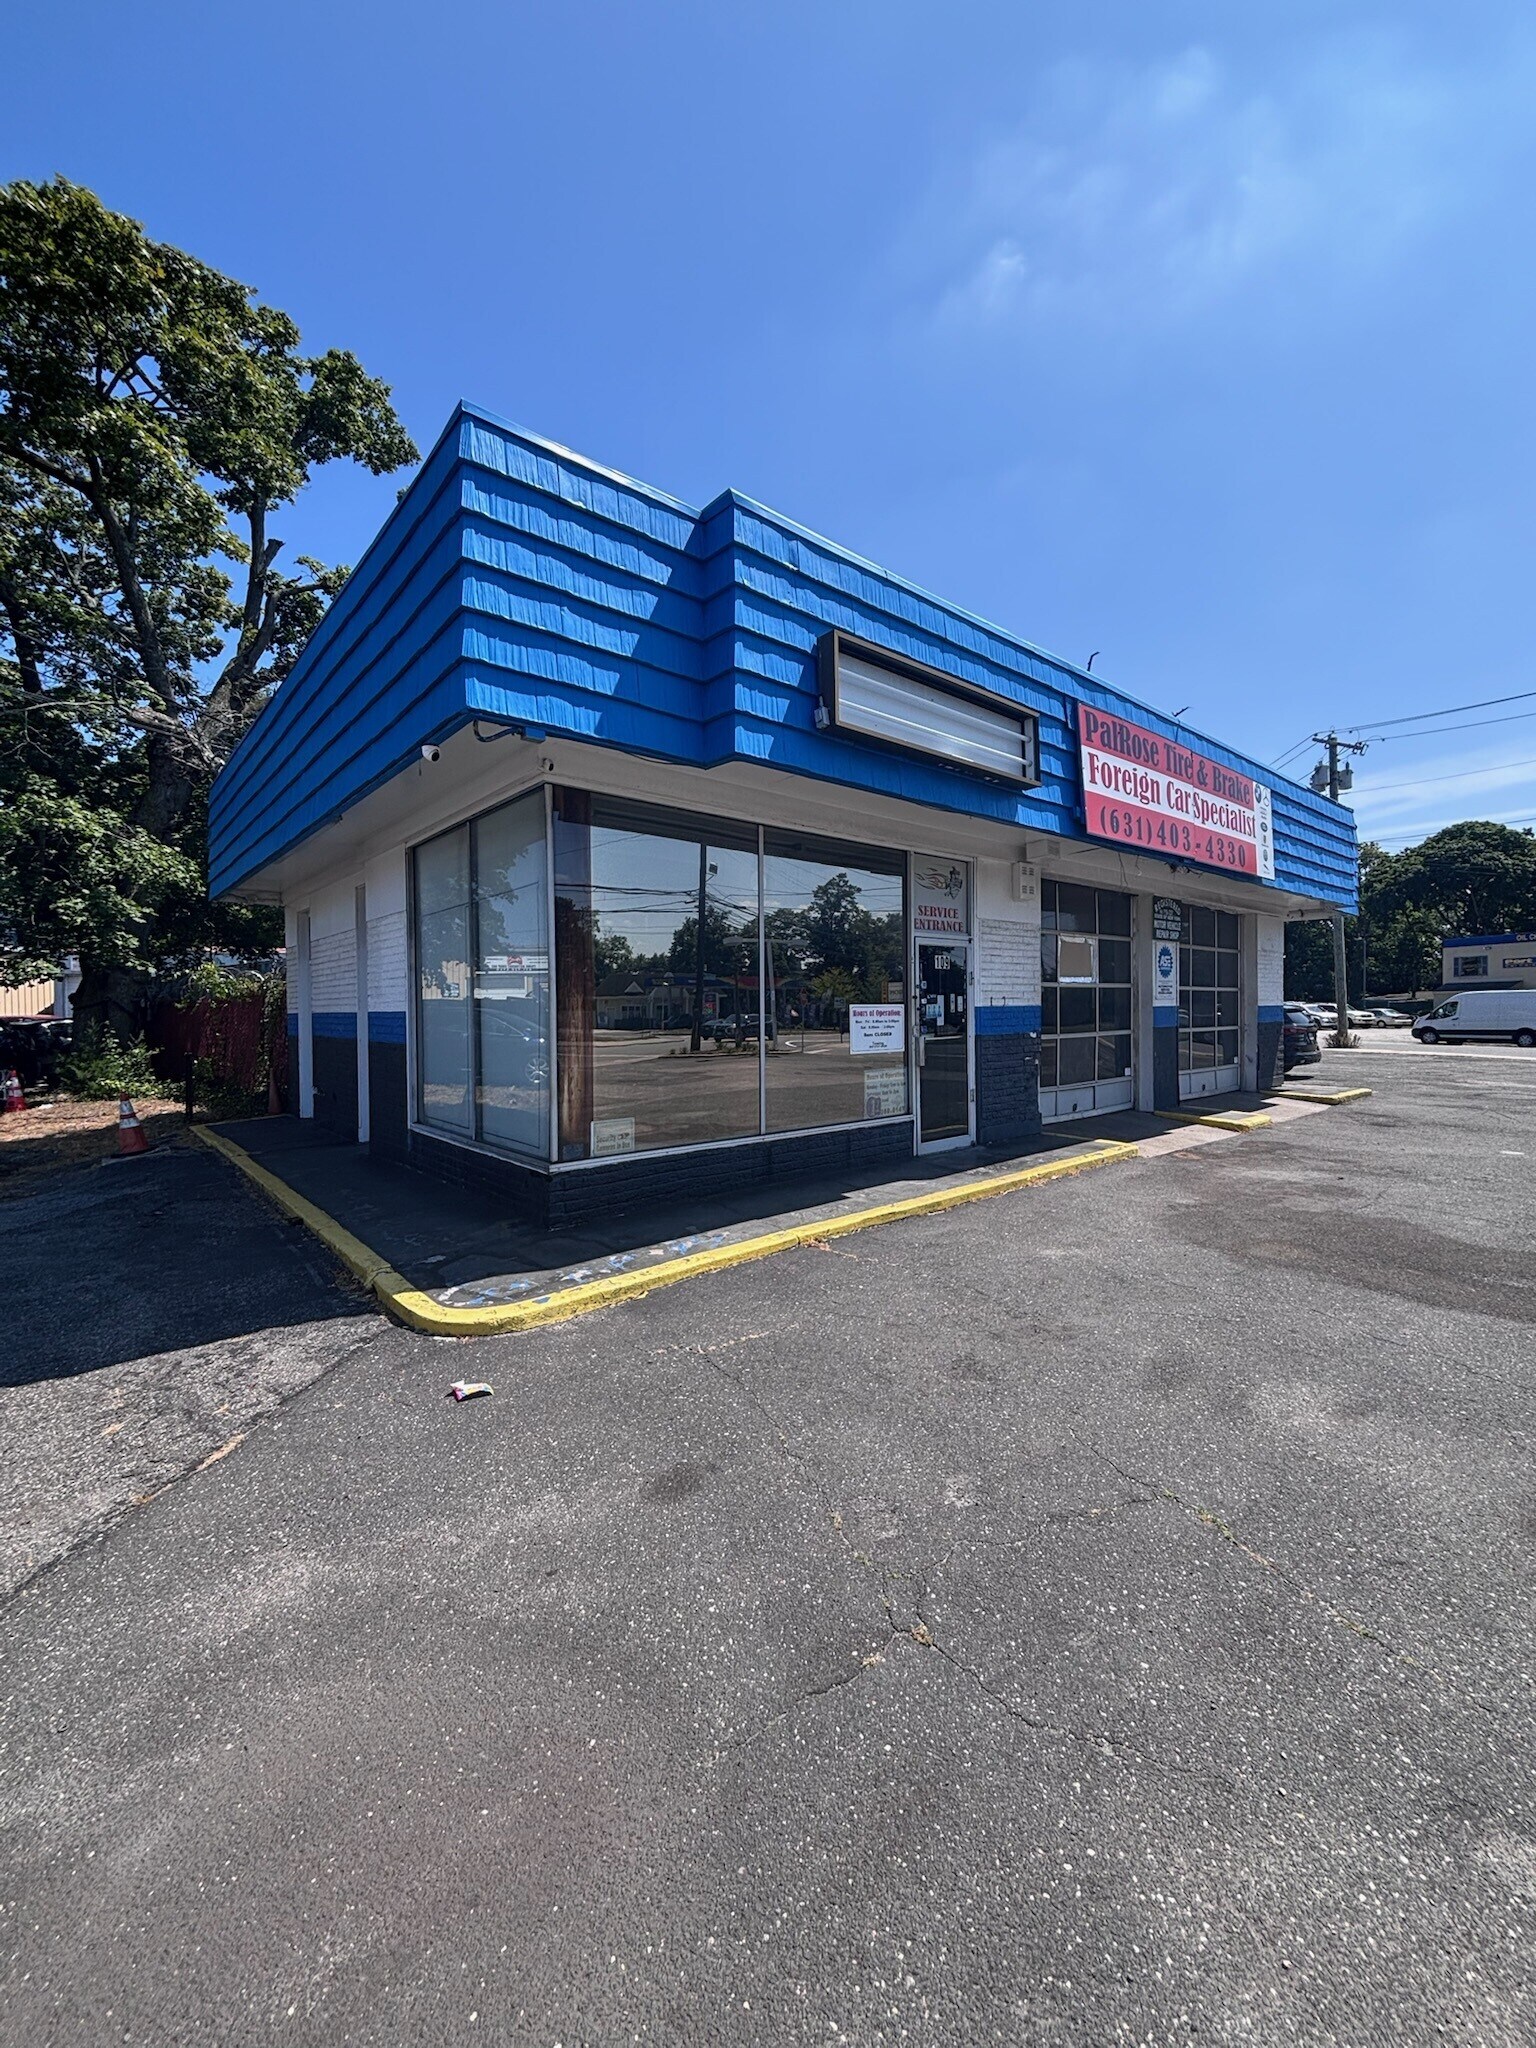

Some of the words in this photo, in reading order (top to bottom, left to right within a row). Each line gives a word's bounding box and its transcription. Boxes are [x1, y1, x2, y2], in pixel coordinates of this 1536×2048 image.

[1164, 743, 1193, 779] Tire
[1197, 760, 1208, 787] &
[1213, 766, 1250, 805] Brake
[1088, 753, 1161, 805] Foreign
[1166, 781, 1191, 815] Car
[1192, 792, 1257, 839] Specialist
[918, 905, 959, 919] SERVICE
[914, 918, 964, 933] ENTRANCE
[935, 955, 951, 970] 109
